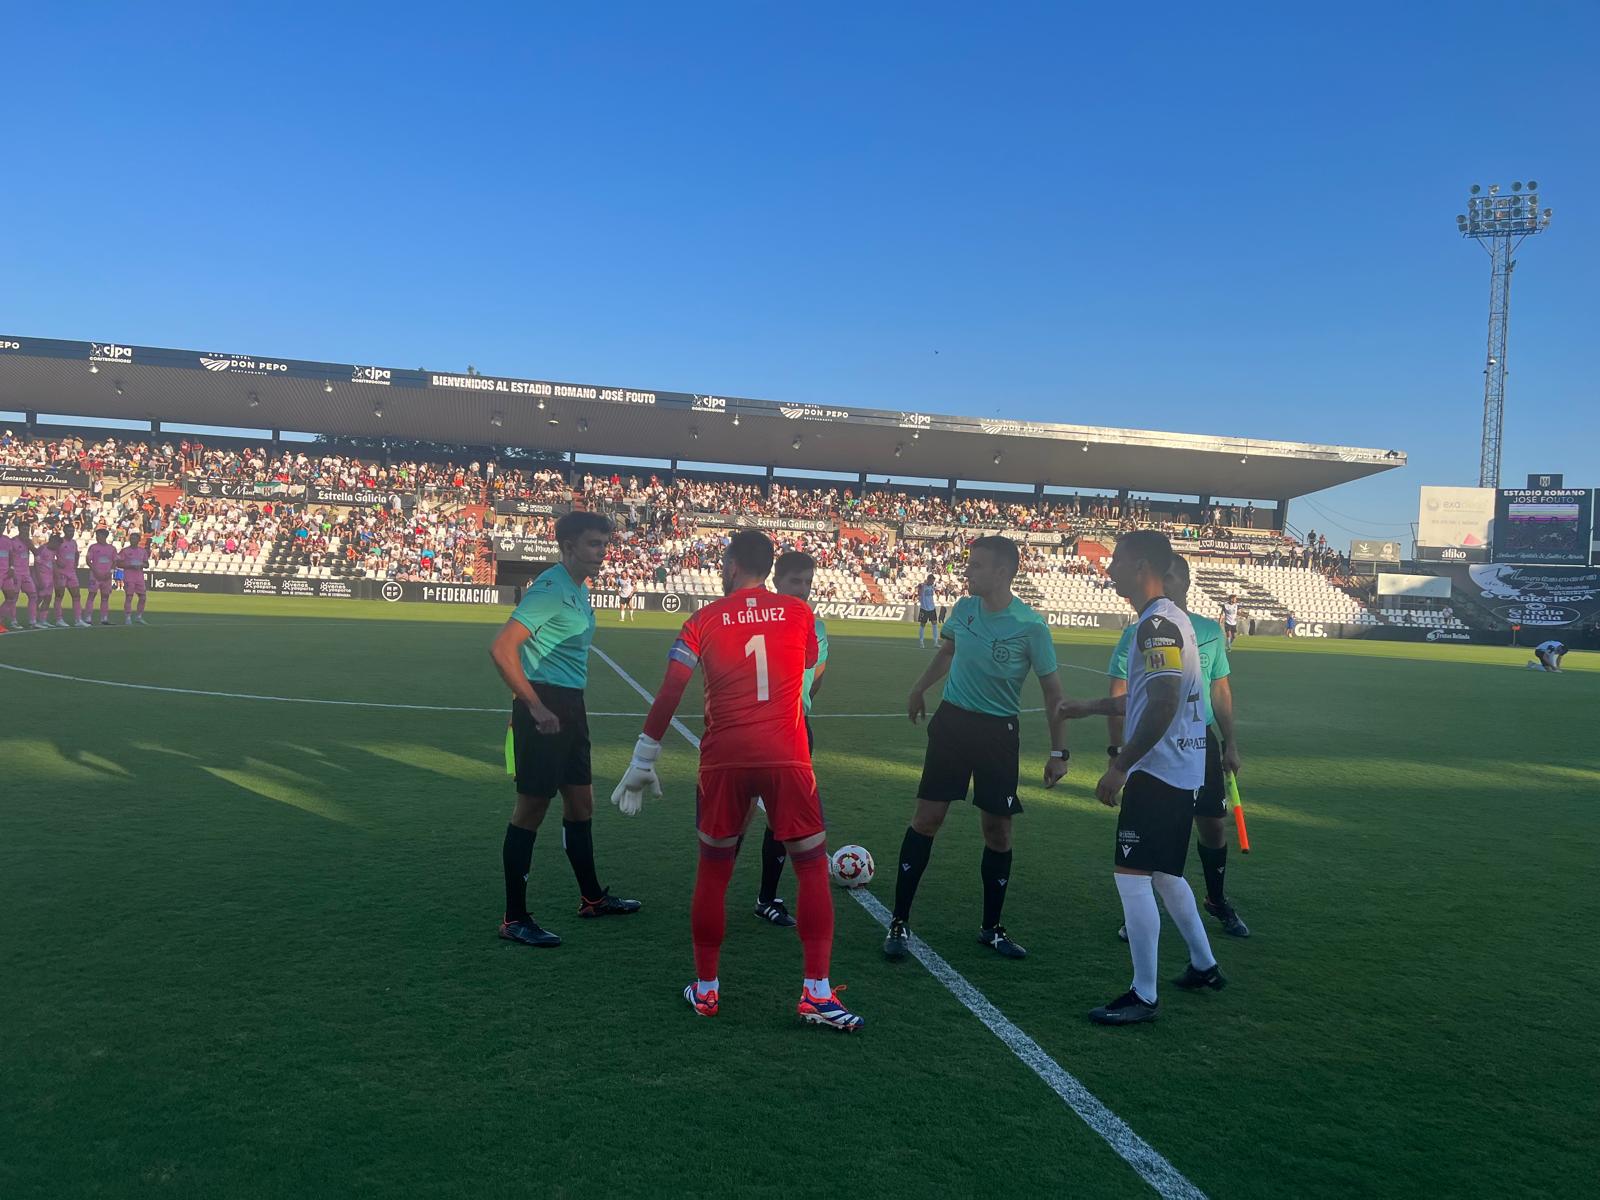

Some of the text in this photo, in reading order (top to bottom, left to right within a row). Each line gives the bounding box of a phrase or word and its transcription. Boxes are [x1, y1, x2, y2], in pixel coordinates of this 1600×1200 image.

[103, 344, 132, 358] cjpa
[231, 360, 288, 372] DON PEPO
[364, 366, 391, 380] cjpa
[432, 375, 656, 404] BIENVENIDOS AL ESTADIO ROMANO JOSÉ FOUTO
[703, 395, 726, 408] cjpa
[804, 408, 849, 418] DON PEPO
[909, 413, 931, 424] cjpa
[317, 490, 387, 503] Estrella Galicia
[756, 517, 815, 529] Estrella Galicia
[435, 587, 499, 604] FEDERACIÓN
[588, 594, 645, 609] EDERAÓN
[722, 607, 786, 625] R. GÁLVEZ
[813, 602, 906, 620] RARATRANS
[744, 634, 769, 701] 1
